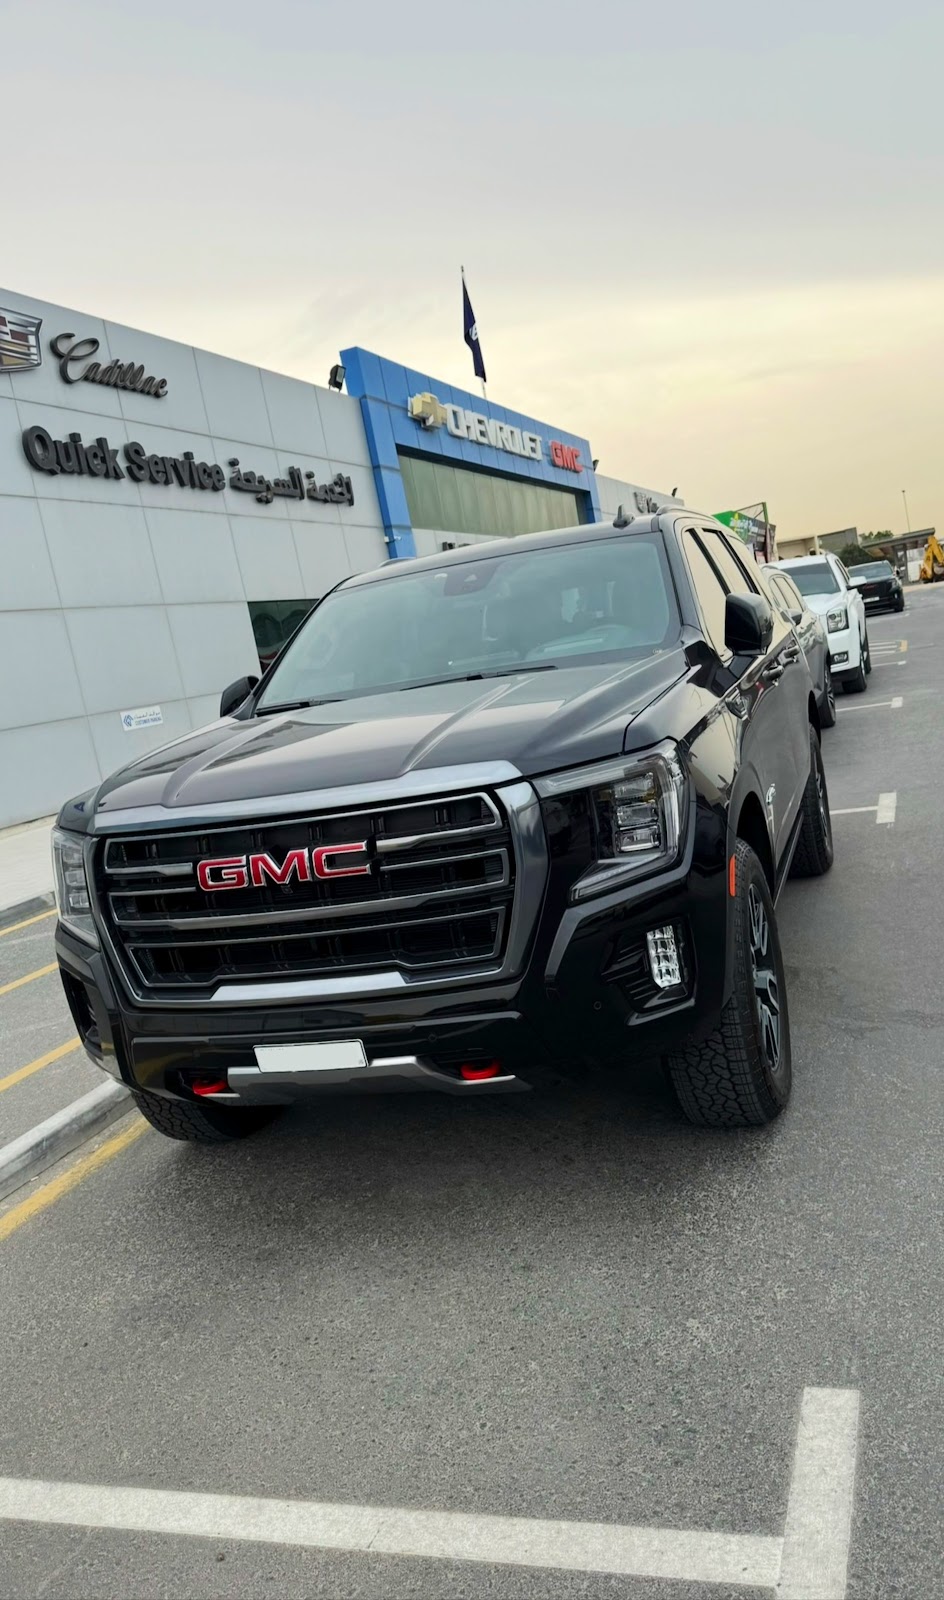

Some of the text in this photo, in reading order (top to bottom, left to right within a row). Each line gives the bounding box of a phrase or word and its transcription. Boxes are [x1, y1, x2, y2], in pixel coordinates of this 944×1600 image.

[49, 332, 168, 398] Cadillac
[22, 425, 226, 491] Quick Service
[446, 403, 543, 461] CHEVROLET
[550, 440, 584, 473] GMC
[228, 457, 355, 507] الخدمة السريعة
[197, 840, 372, 892] GMC
